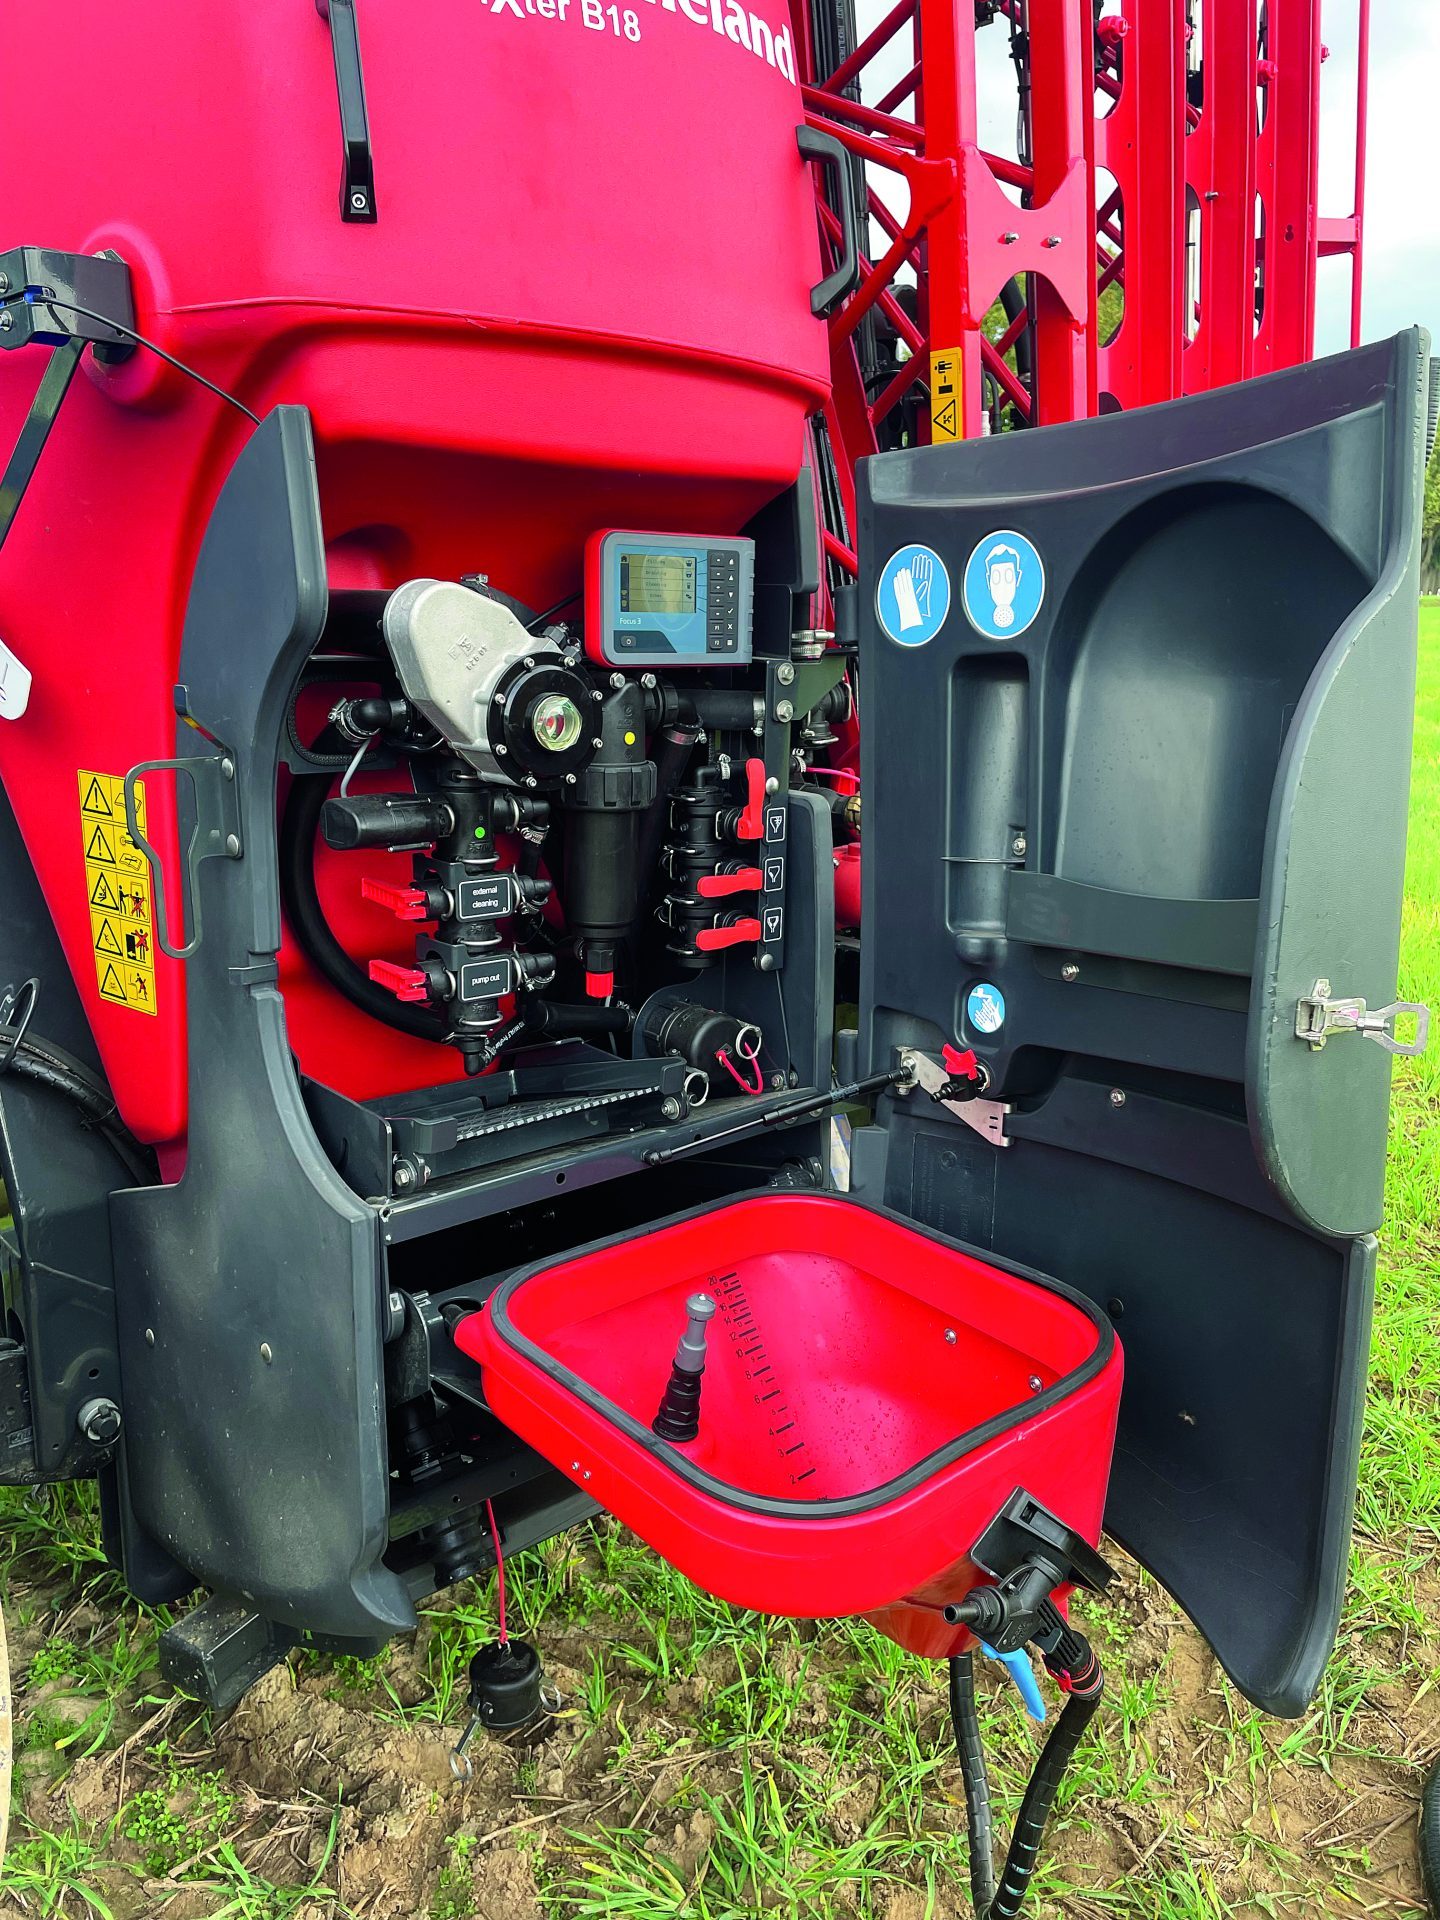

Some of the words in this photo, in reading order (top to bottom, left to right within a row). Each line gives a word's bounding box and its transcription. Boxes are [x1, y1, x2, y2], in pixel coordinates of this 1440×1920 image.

[581, 0, 642, 42] B18
[619, 617, 636, 625] Focus
[636, 617, 641, 625] 3
[472, 886, 498, 896] external
[472, 899, 499, 908] cleaning
[471, 976, 490, 987] pump
[490, 973, 500, 982] out
[708, 1275, 718, 1286] 20
[729, 1331, 738, 1341] 12
[736, 1348, 744, 1359] 10
[745, 1370, 751, 1380] 8
[754, 1394, 761, 1404] 6
[769, 1428, 774, 1437] 4
[778, 1448, 784, 1458] 3
[790, 1474, 796, 1484] 2
